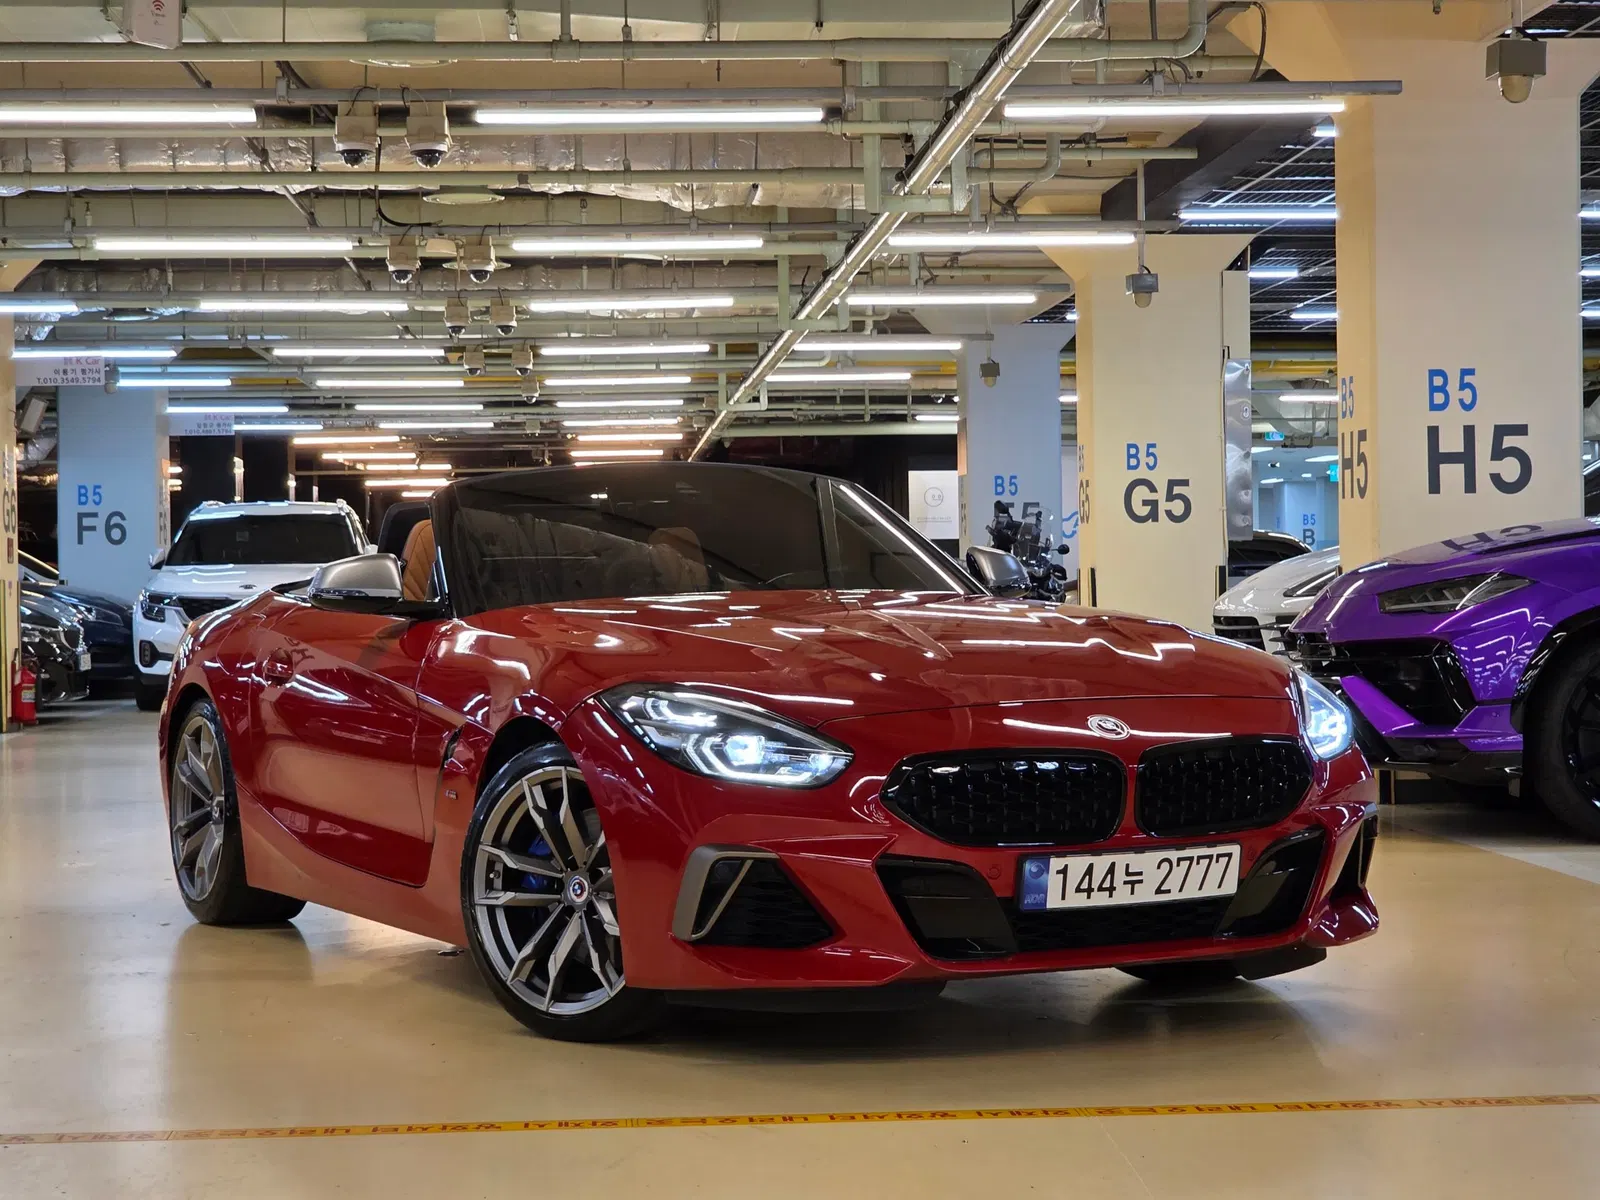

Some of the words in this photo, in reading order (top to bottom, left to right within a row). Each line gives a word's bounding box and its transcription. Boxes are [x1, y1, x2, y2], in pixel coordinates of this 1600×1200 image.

[86, 356, 100, 365] Car
[1341, 375, 1354, 419] B5
[1427, 367, 1478, 412] B5
[1126, 442, 1158, 471] B5
[1341, 428, 1369, 500] H5
[1426, 423, 1533, 495] H5
[77, 484, 103, 506] B5
[994, 475, 1018, 496] B5
[1078, 479, 1090, 525] G5
[1123, 478, 1193, 524] G5
[3, 487, 16, 534] G6
[76, 510, 127, 546] F6
[1303, 513, 1316, 526] B5
[1055, 860, 1145, 901] 144누
[1154, 852, 1234, 895] 2777
